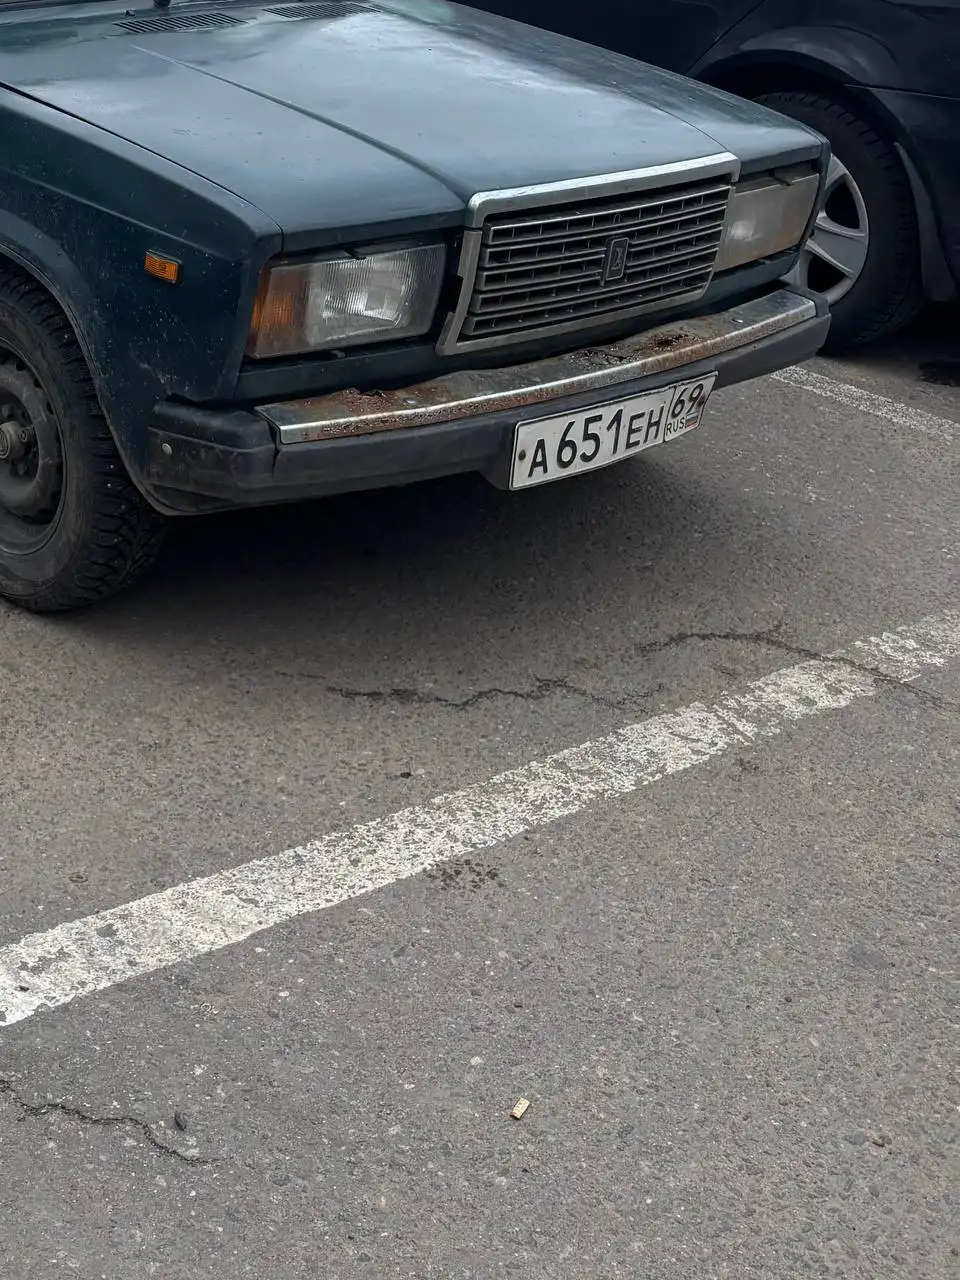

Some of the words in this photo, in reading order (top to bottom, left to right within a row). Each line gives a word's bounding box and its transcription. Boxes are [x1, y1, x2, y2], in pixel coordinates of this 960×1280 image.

[527, 405, 665, 478] А651ЕН
[671, 383, 705, 419] 69
[665, 418, 686, 437] RUS
